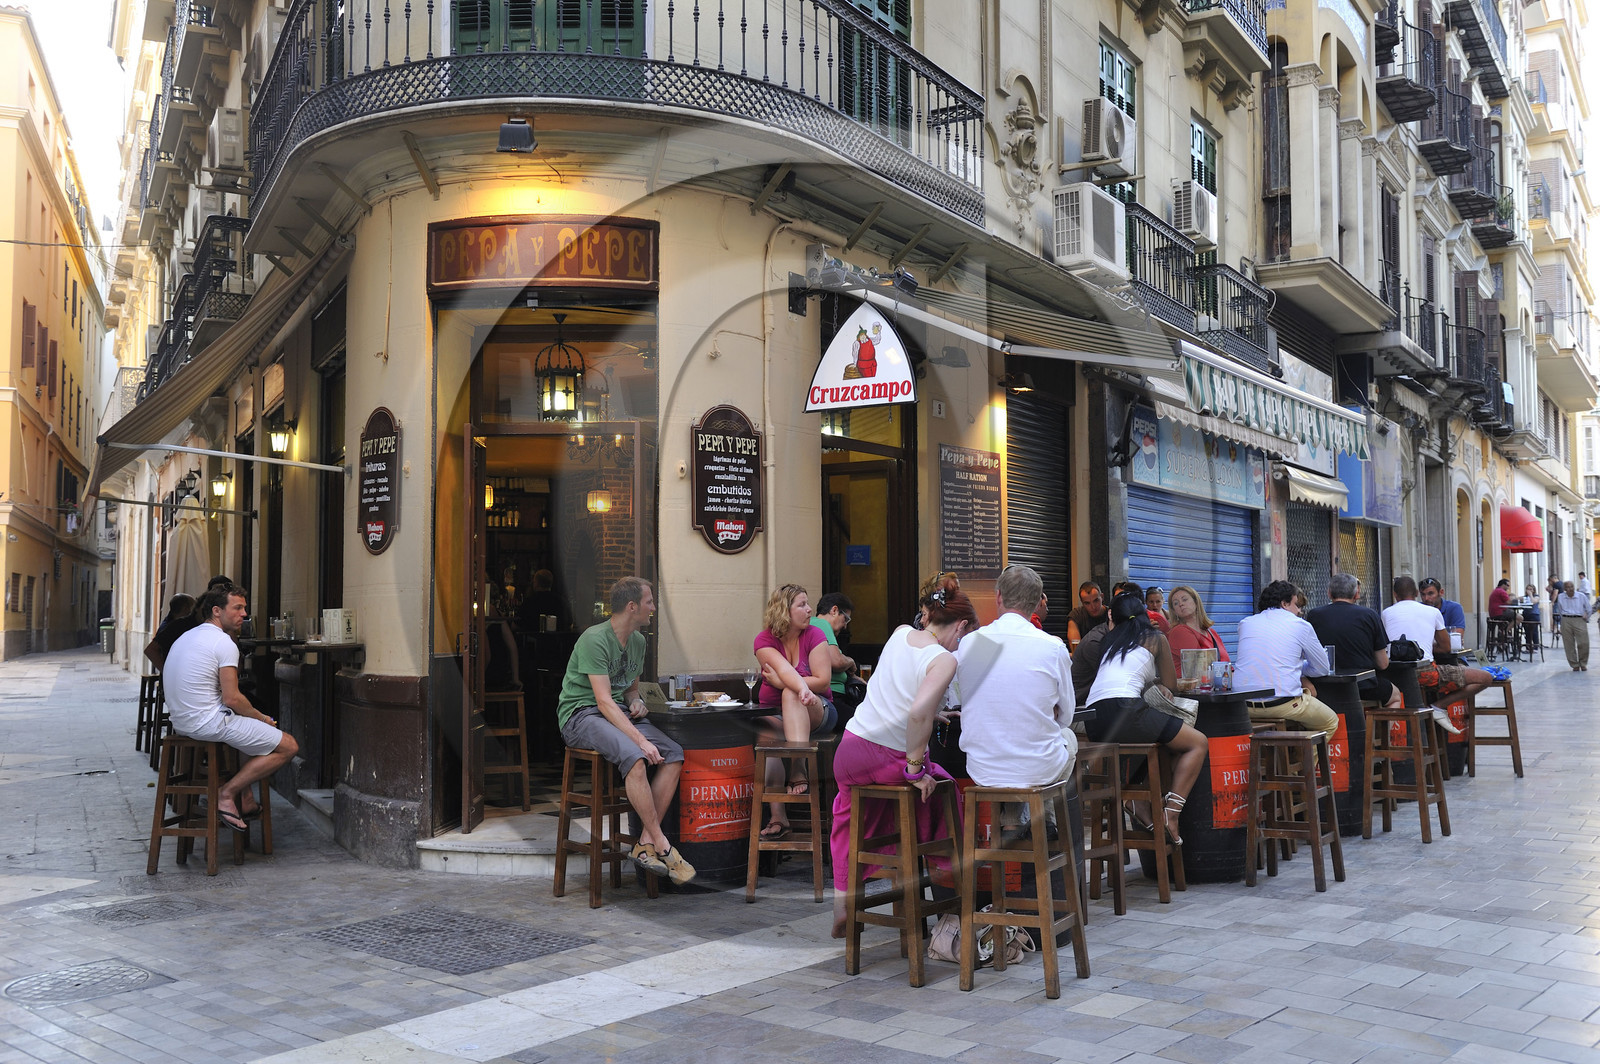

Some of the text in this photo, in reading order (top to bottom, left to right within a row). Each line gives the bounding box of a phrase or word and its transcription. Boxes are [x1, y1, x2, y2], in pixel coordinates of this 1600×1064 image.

[439, 228, 522, 280] PEPA
[557, 227, 647, 279] PEPE
[810, 380, 912, 404] Cruzcampo
[1212, 373, 1237, 413] BAR
[1241, 384, 1256, 420] DE
[1134, 417, 1157, 438] PEPSI
[379, 436, 396, 454] PEPE
[697, 433, 758, 456] PEPA Y PEPE
[941, 448, 999, 469] Pepa y Pepe
[955, 471, 988, 482] HALF RATION
[707, 484, 752, 496] embutidos
[716, 521, 744, 531] Mahou
[710, 758, 738, 767] TINTO
